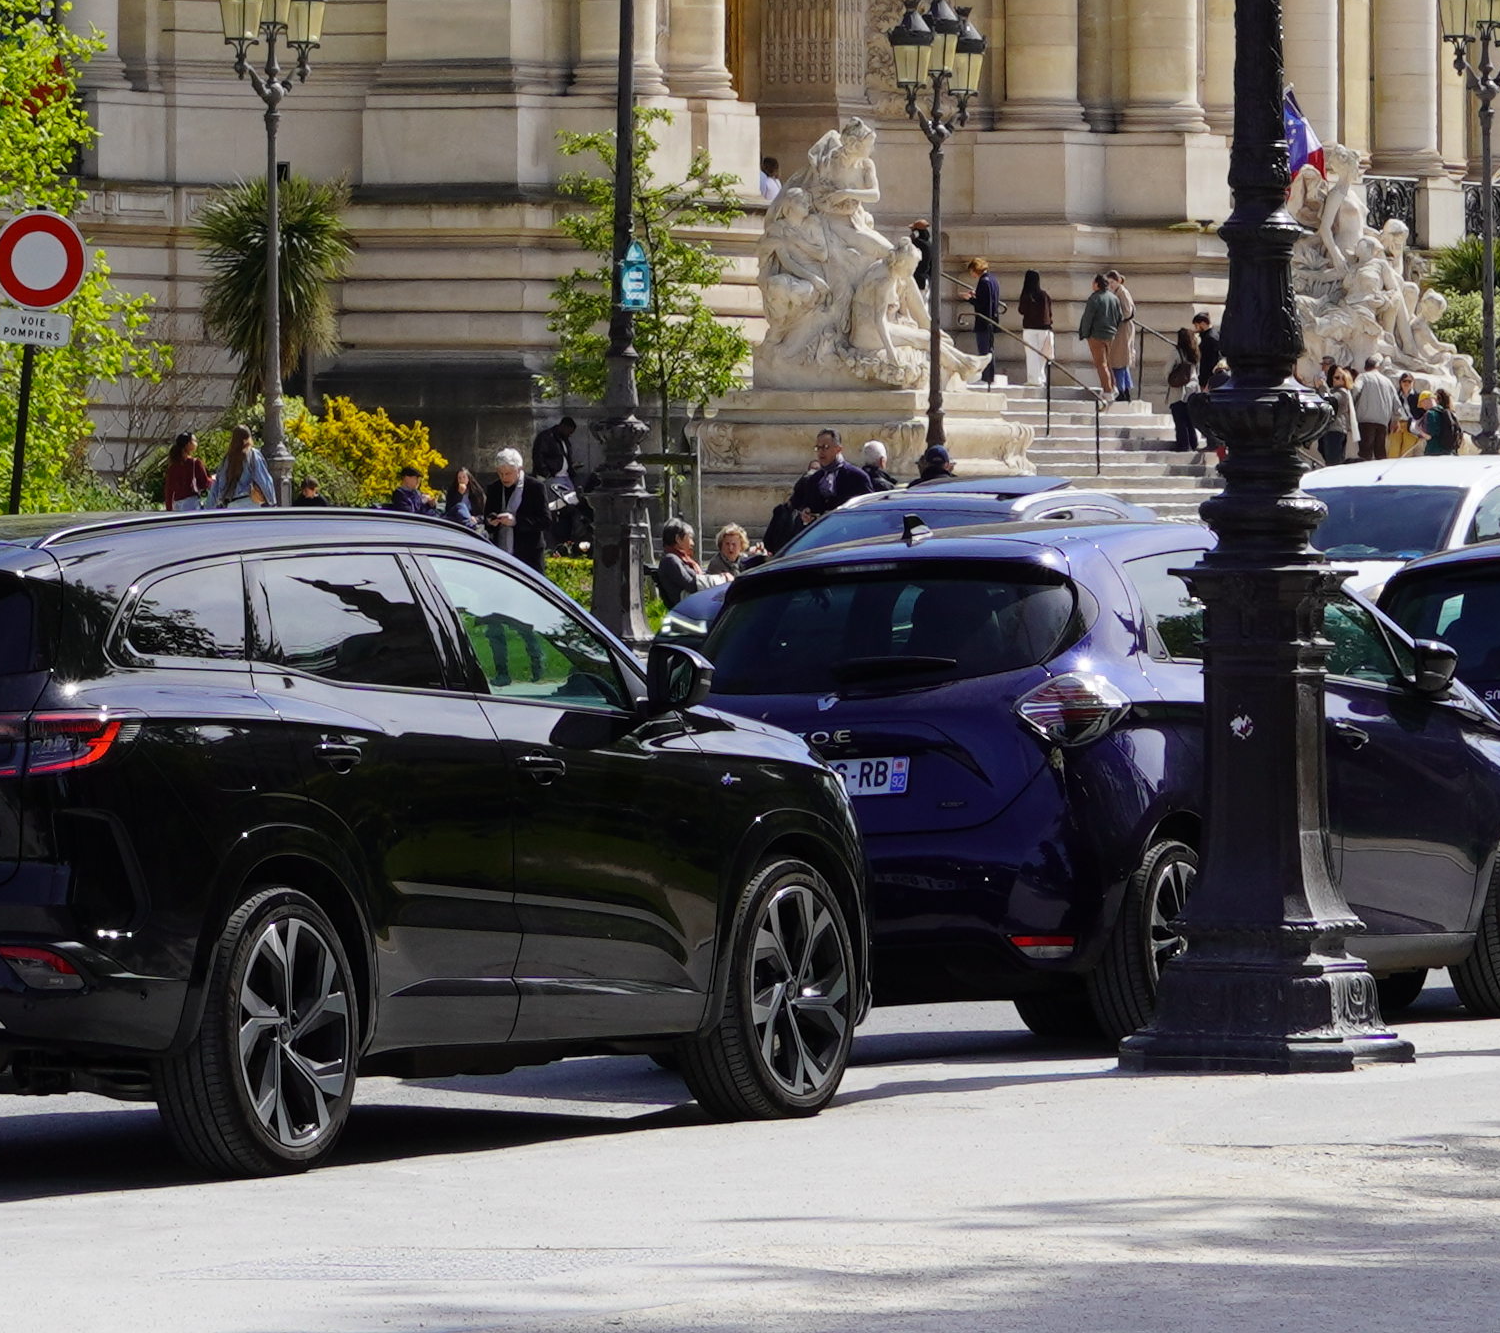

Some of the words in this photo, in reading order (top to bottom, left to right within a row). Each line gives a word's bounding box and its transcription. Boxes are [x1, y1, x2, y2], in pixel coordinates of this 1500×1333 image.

[21, 316, 46, 327] VOIE
[3, 326, 60, 341] POMPIERS
[891, 775, 905, 788] 92
